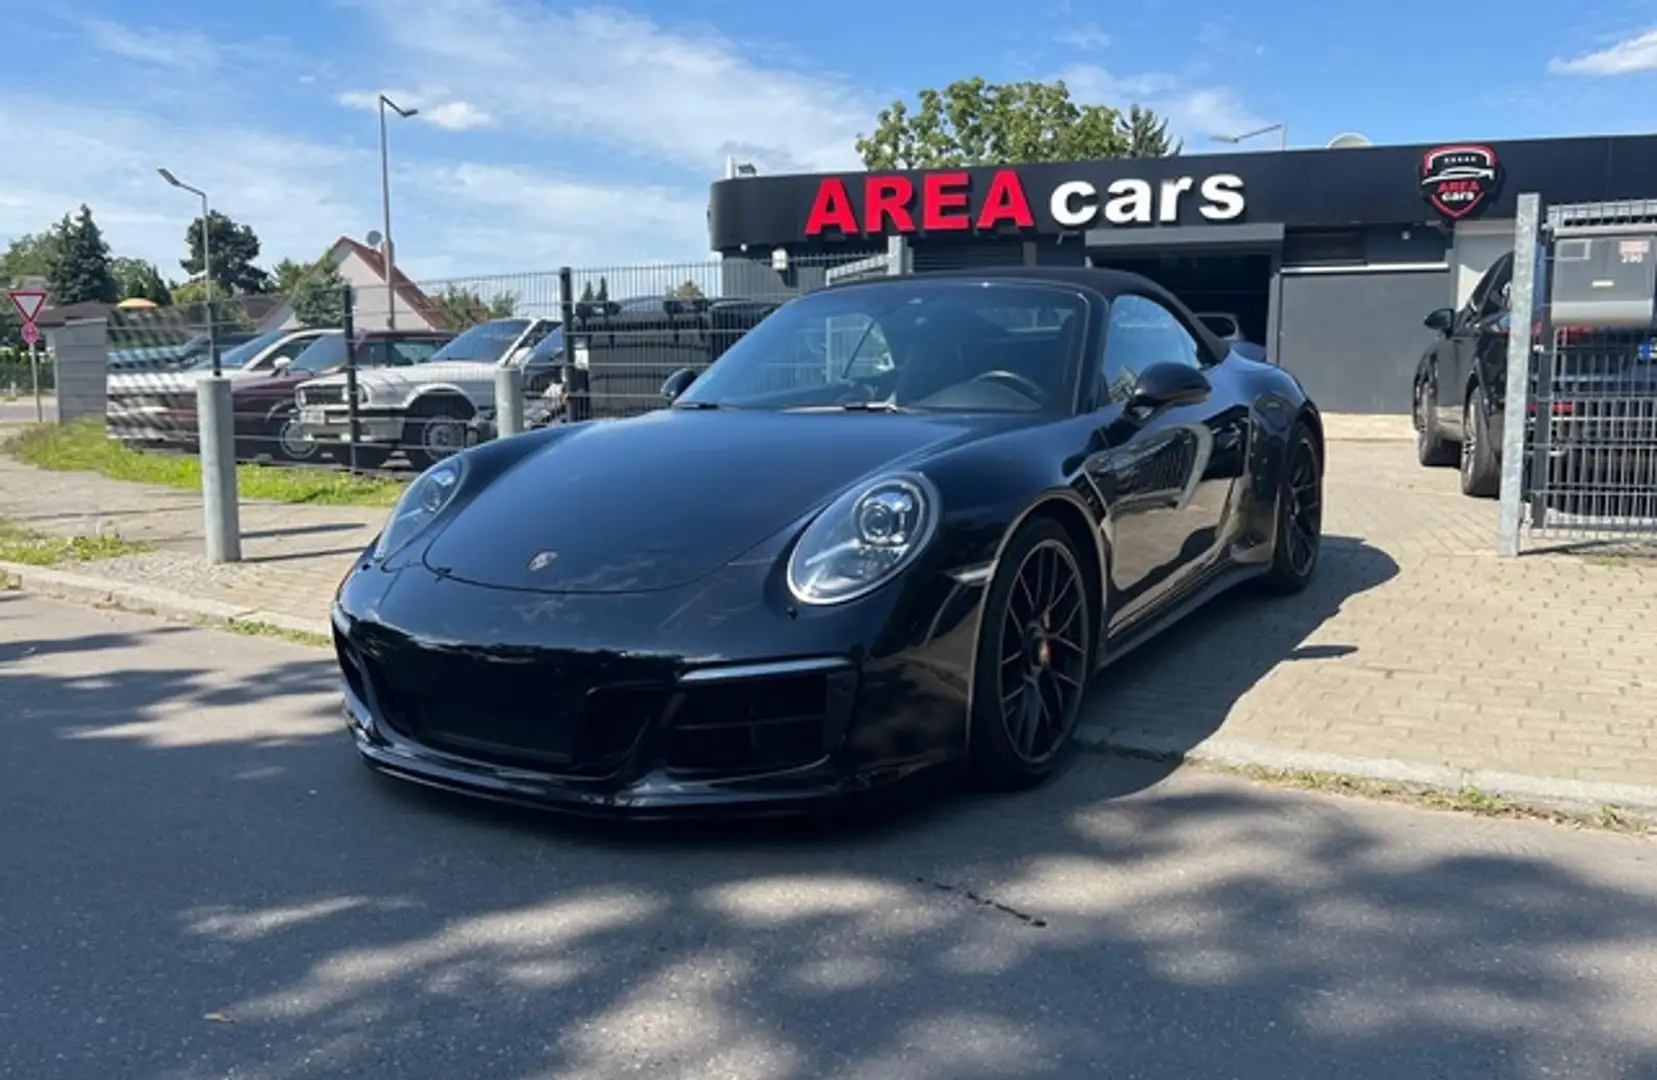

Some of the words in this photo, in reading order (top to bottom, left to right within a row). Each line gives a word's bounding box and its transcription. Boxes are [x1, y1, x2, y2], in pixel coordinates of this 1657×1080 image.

[1438, 180, 1480, 192] AREA
[805, 170, 1033, 234] AREA
[1050, 174, 1245, 225] cars
[1441, 191, 1475, 202] cars
